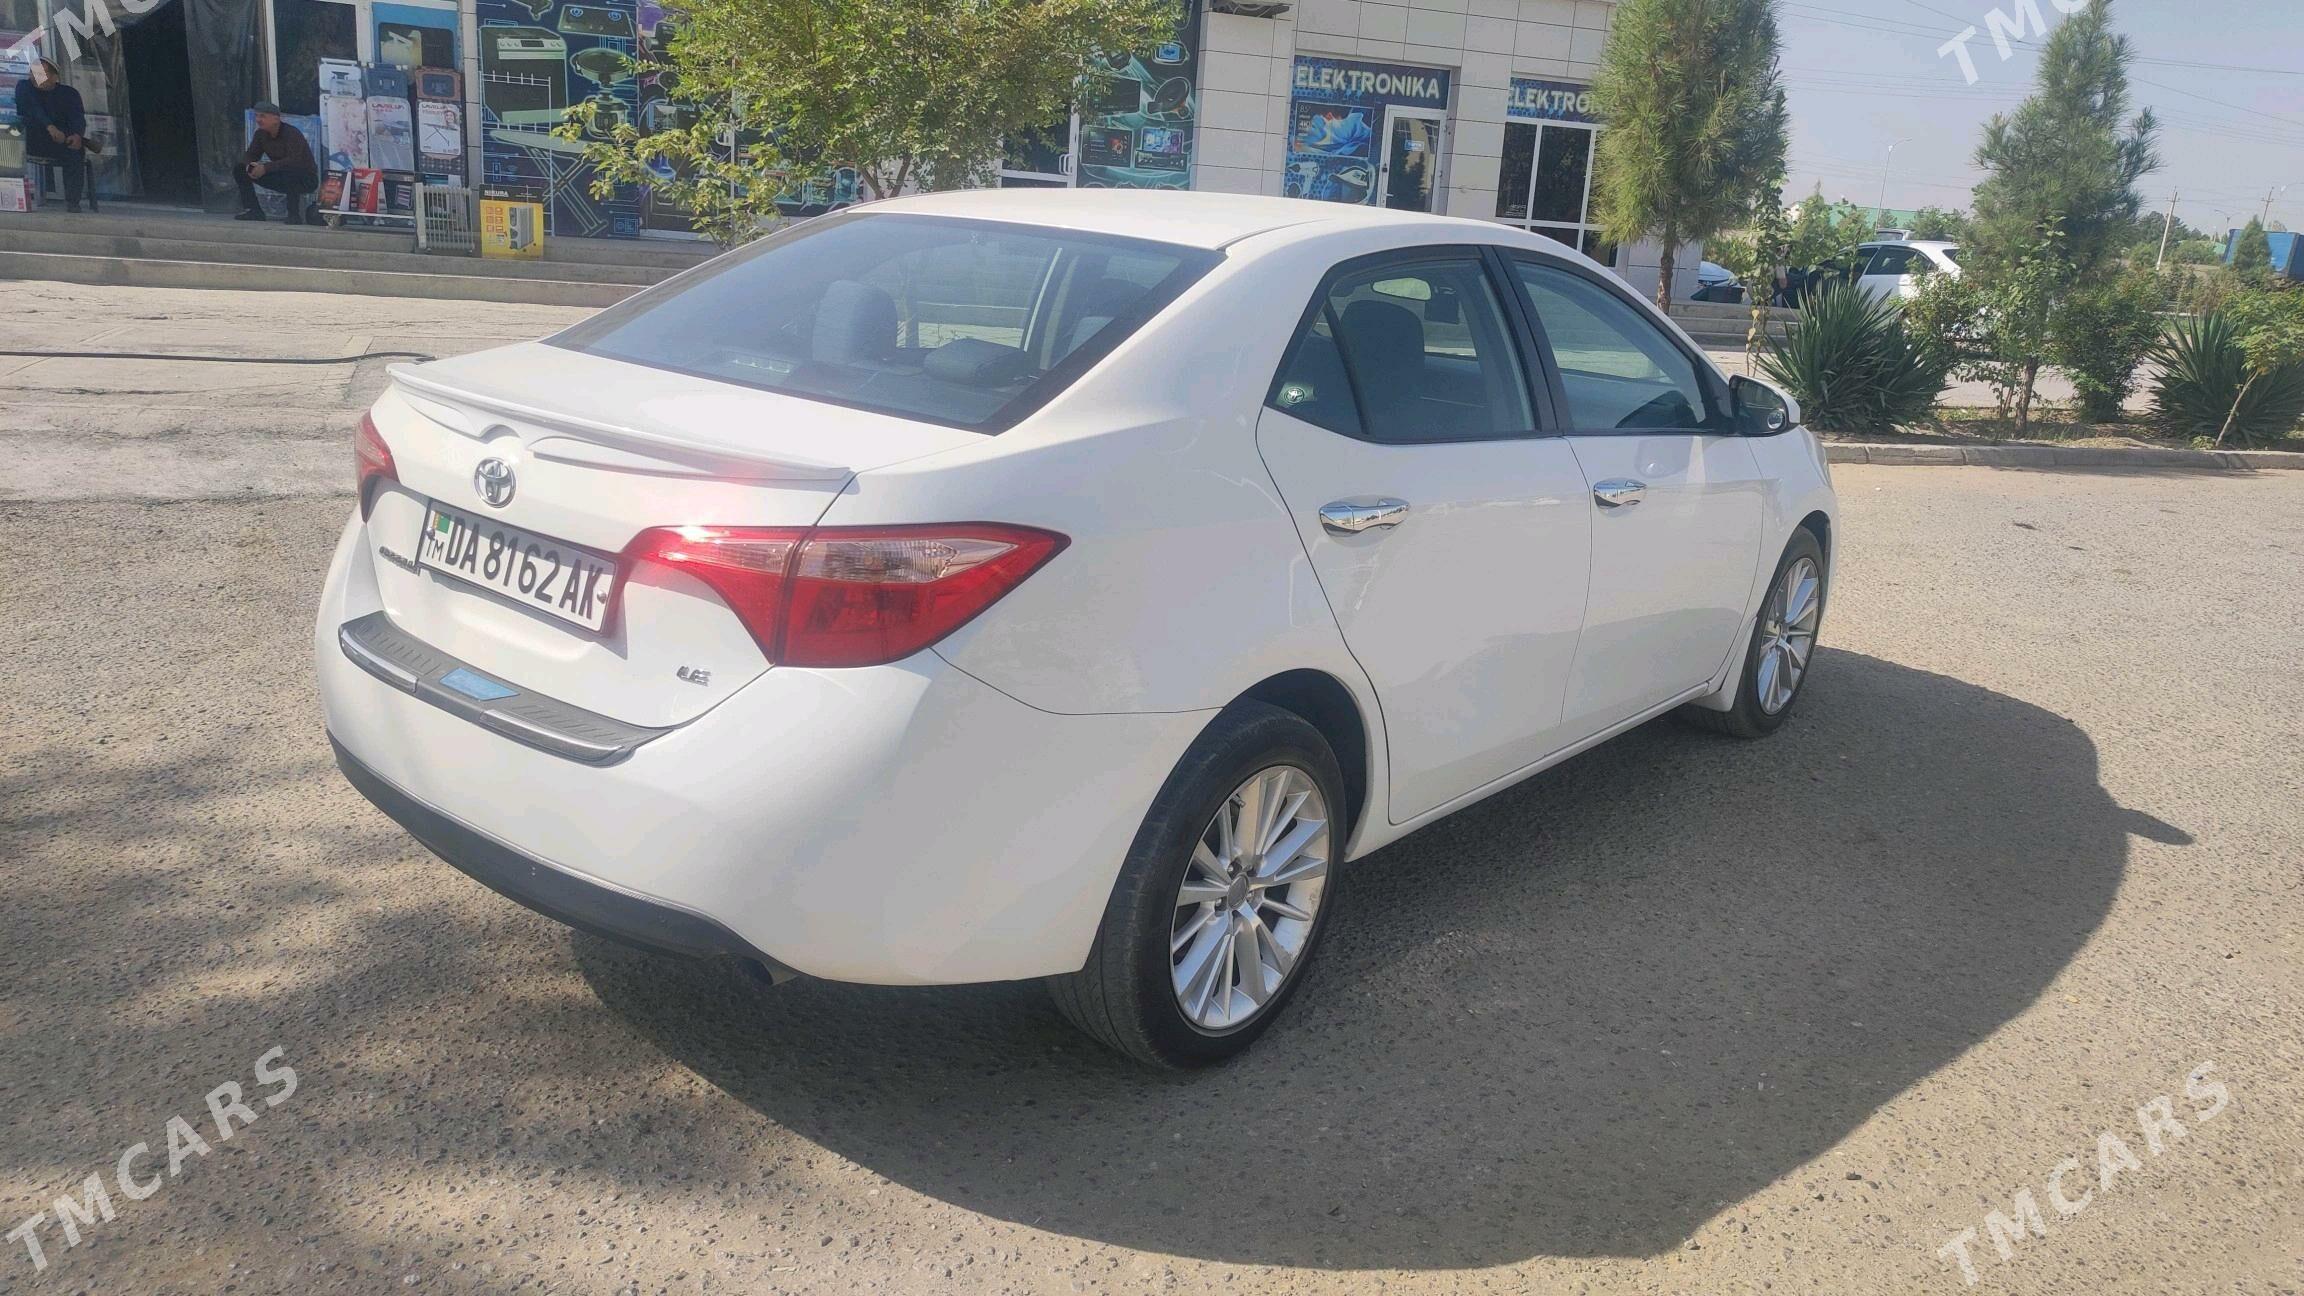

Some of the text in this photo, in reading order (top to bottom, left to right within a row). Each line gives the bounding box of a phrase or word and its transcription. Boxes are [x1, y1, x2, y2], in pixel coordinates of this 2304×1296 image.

[1295, 65, 1440, 99] ELEKTRONIKA
[1508, 86, 1602, 113] ELEKTRO
[426, 539, 445, 562] TM
[445, 516, 481, 574] DA
[483, 531, 561, 604] 8162
[559, 558, 604, 620] AK
